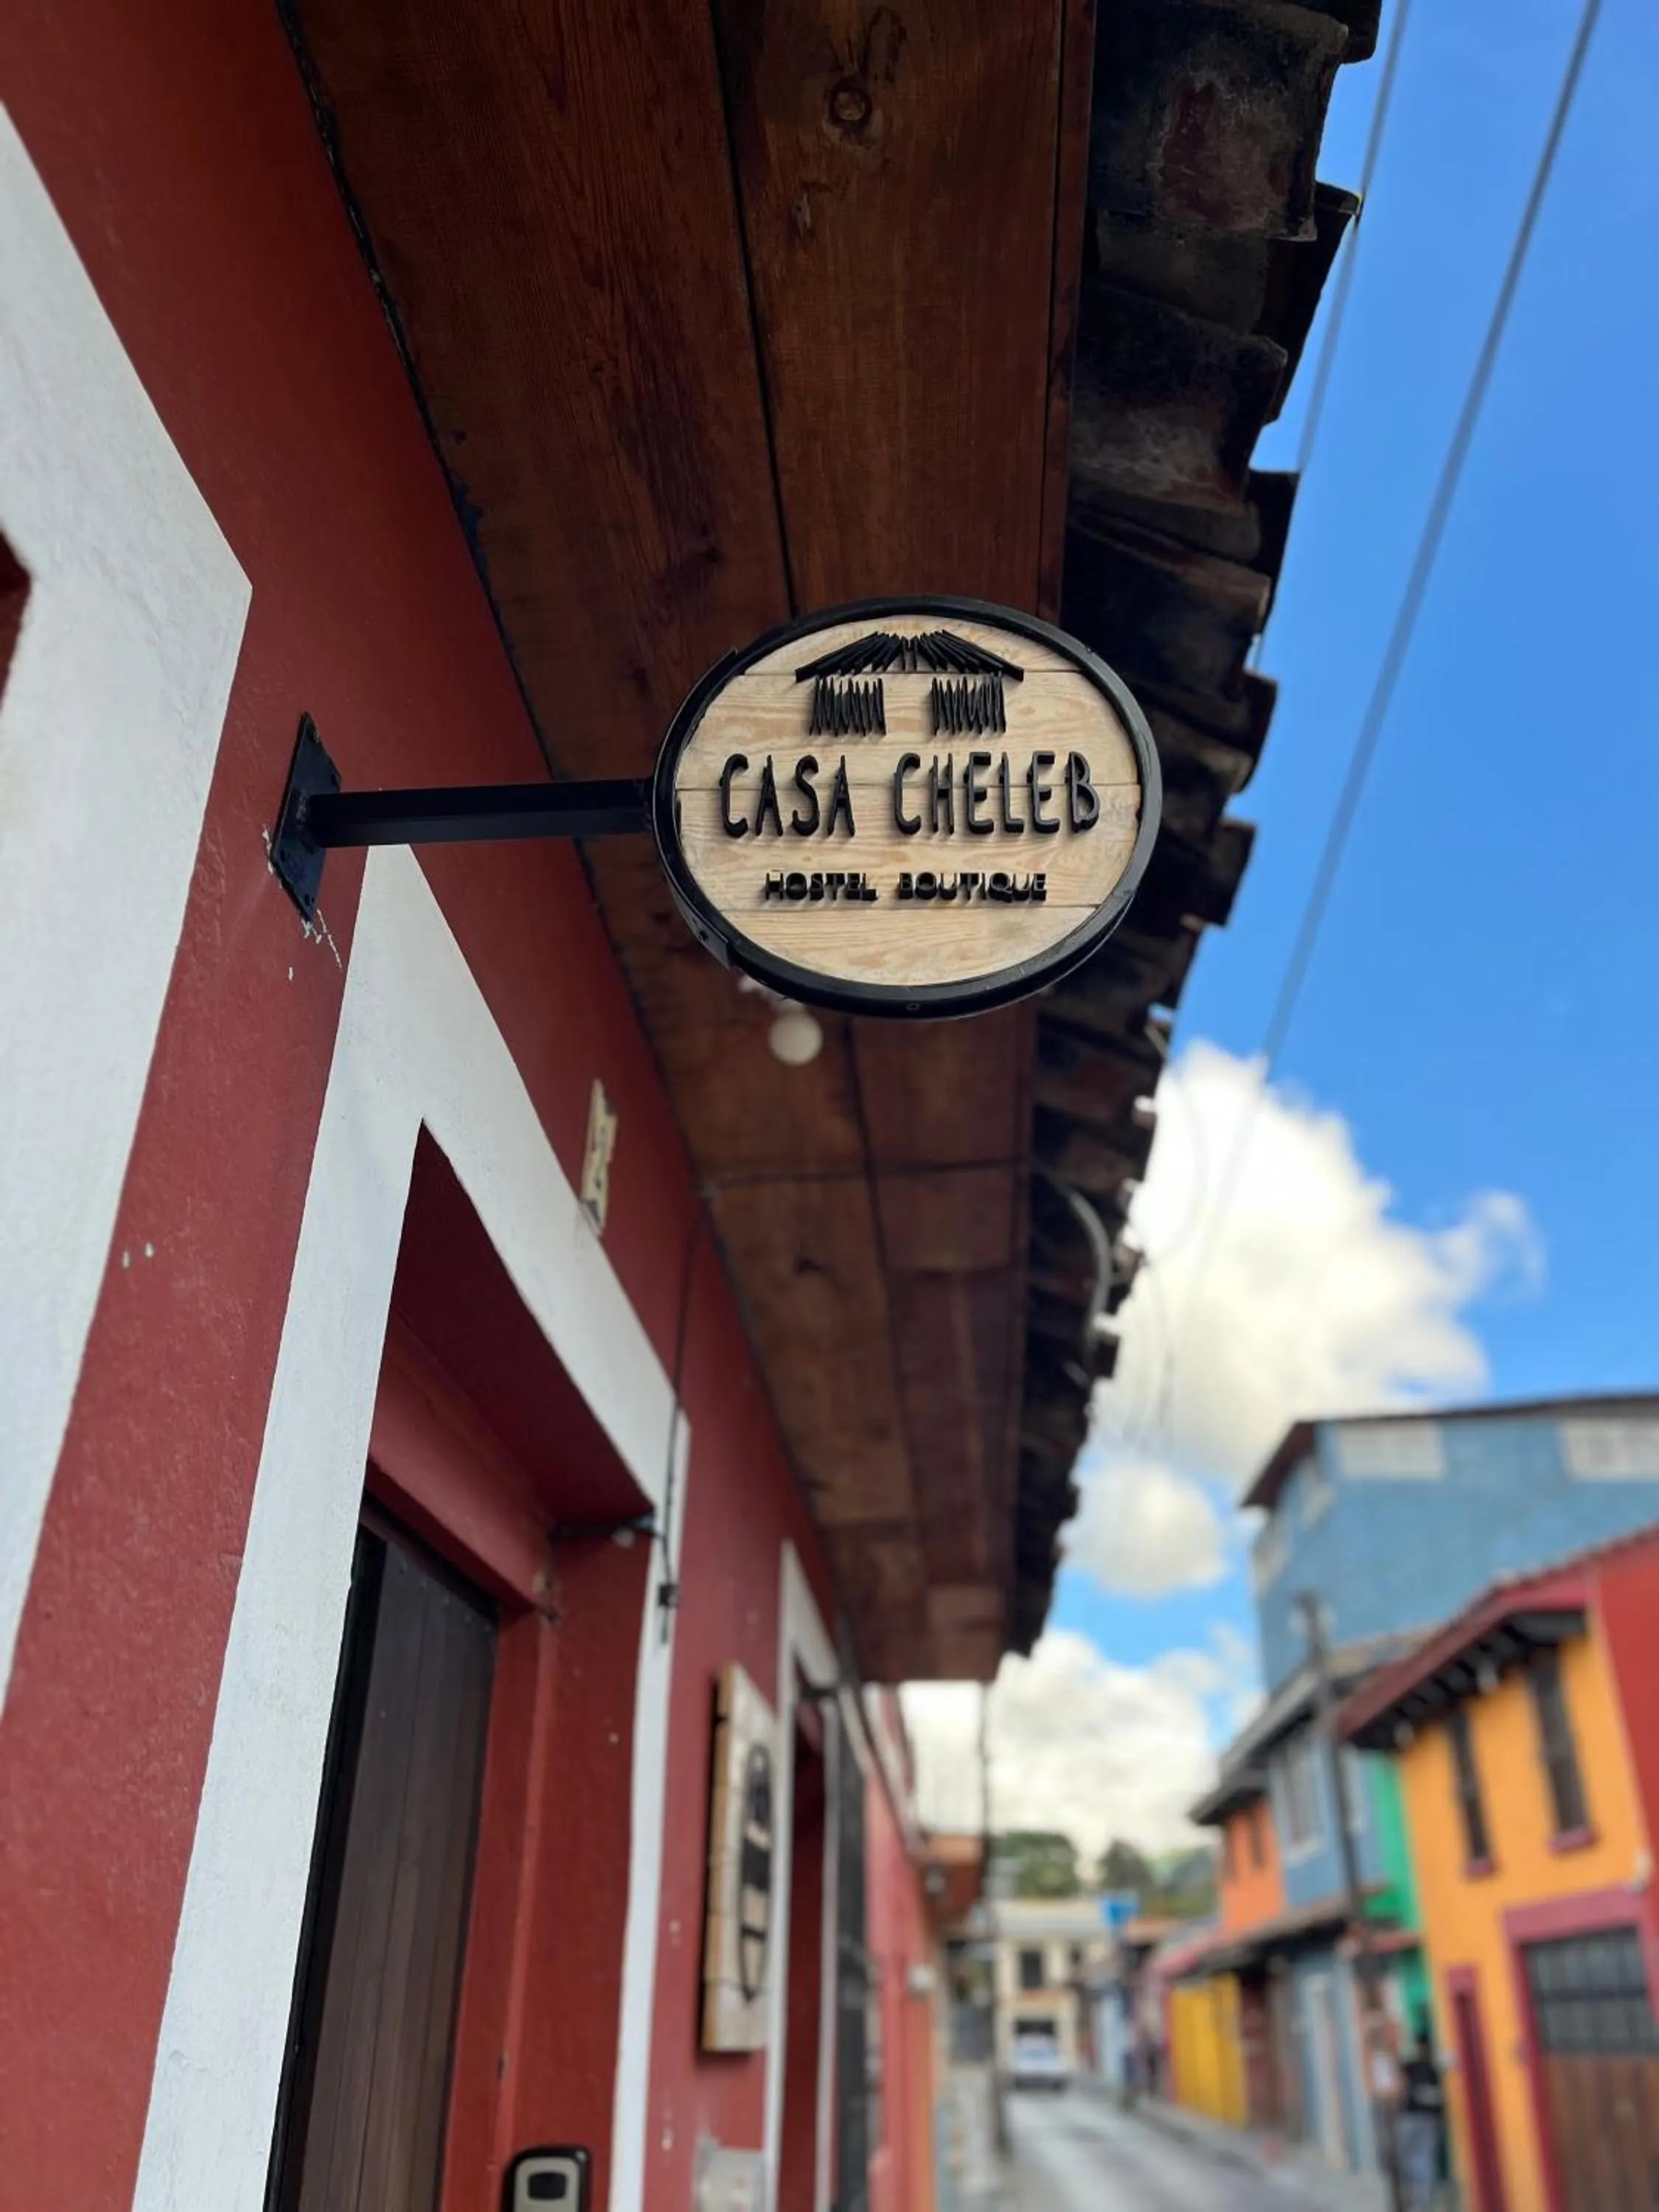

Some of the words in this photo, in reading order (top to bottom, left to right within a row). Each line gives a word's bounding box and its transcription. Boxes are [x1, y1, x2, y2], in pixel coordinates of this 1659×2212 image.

[720, 754, 855, 838] CASA
[894, 751, 1101, 835] CHELEB
[764, 872, 877, 902] HOSTEL
[898, 872, 1047, 902] BOUTIQUE
